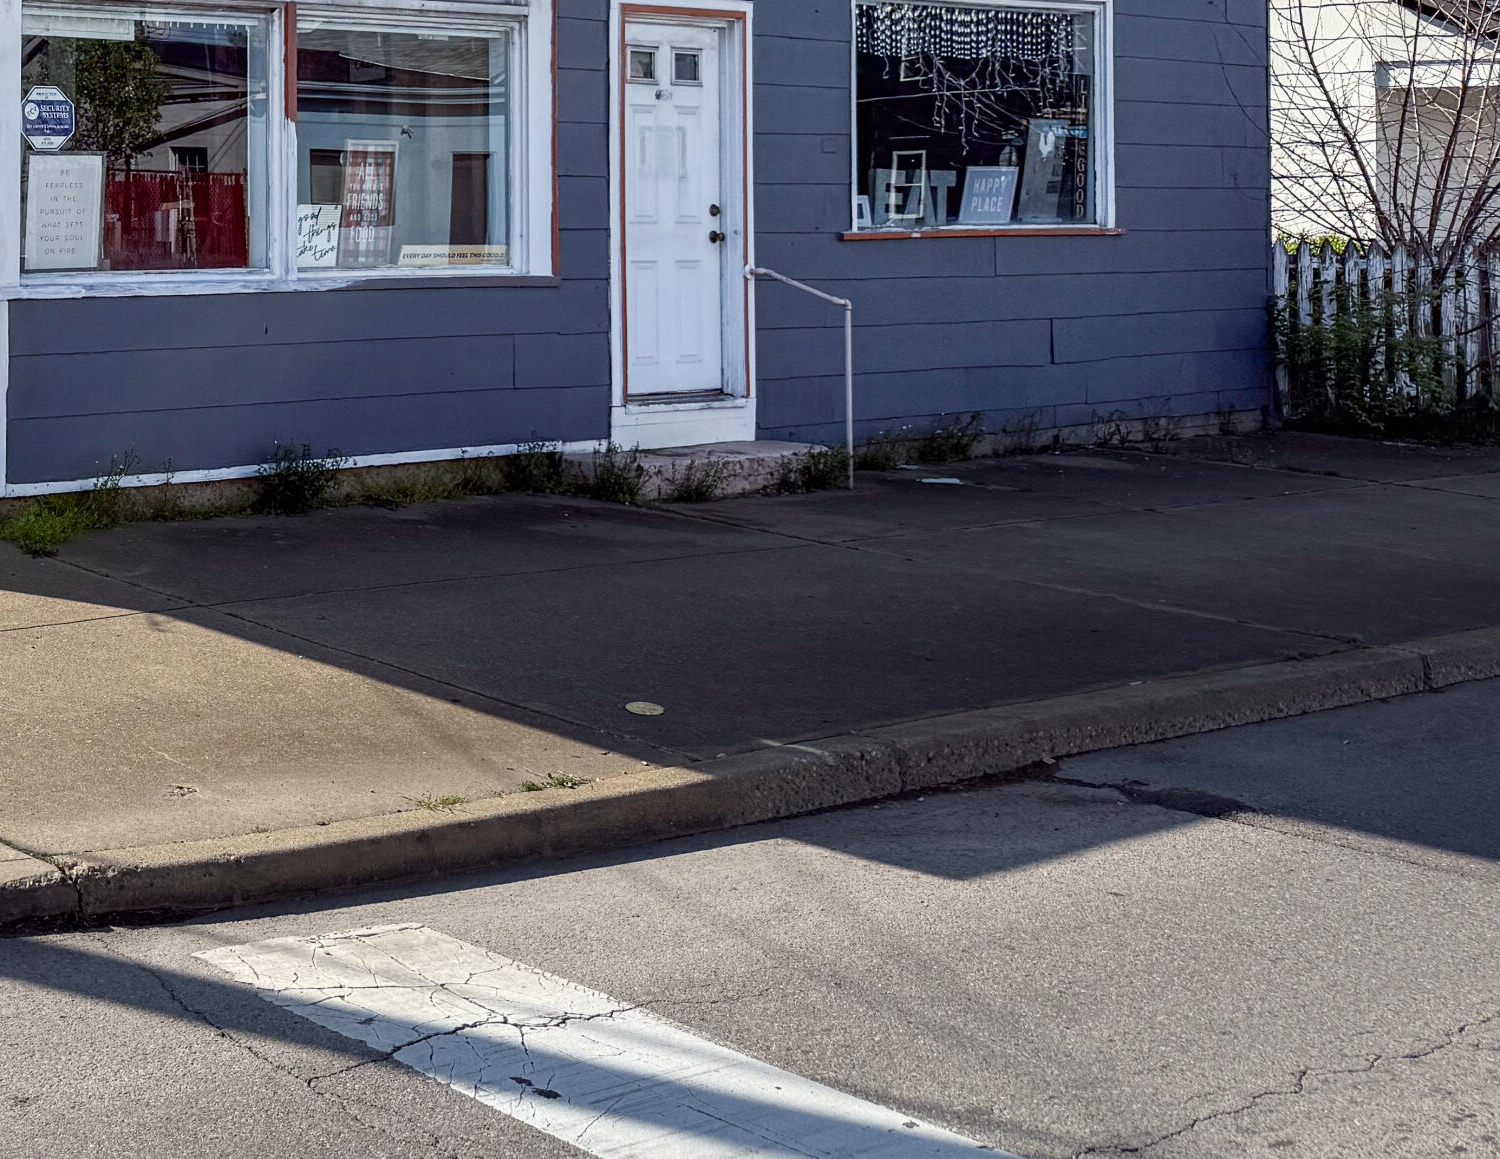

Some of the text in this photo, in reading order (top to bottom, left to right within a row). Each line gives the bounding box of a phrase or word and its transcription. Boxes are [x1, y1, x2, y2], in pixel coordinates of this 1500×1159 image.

[973, 177, 1008, 194] HAPPY
[346, 193, 383, 211] FRIENDS
[874, 168, 957, 225] EAT
[971, 196, 1003, 212] PLACE
[350, 225, 375, 242] FOOD
[59, 247, 77, 255] FIRE
